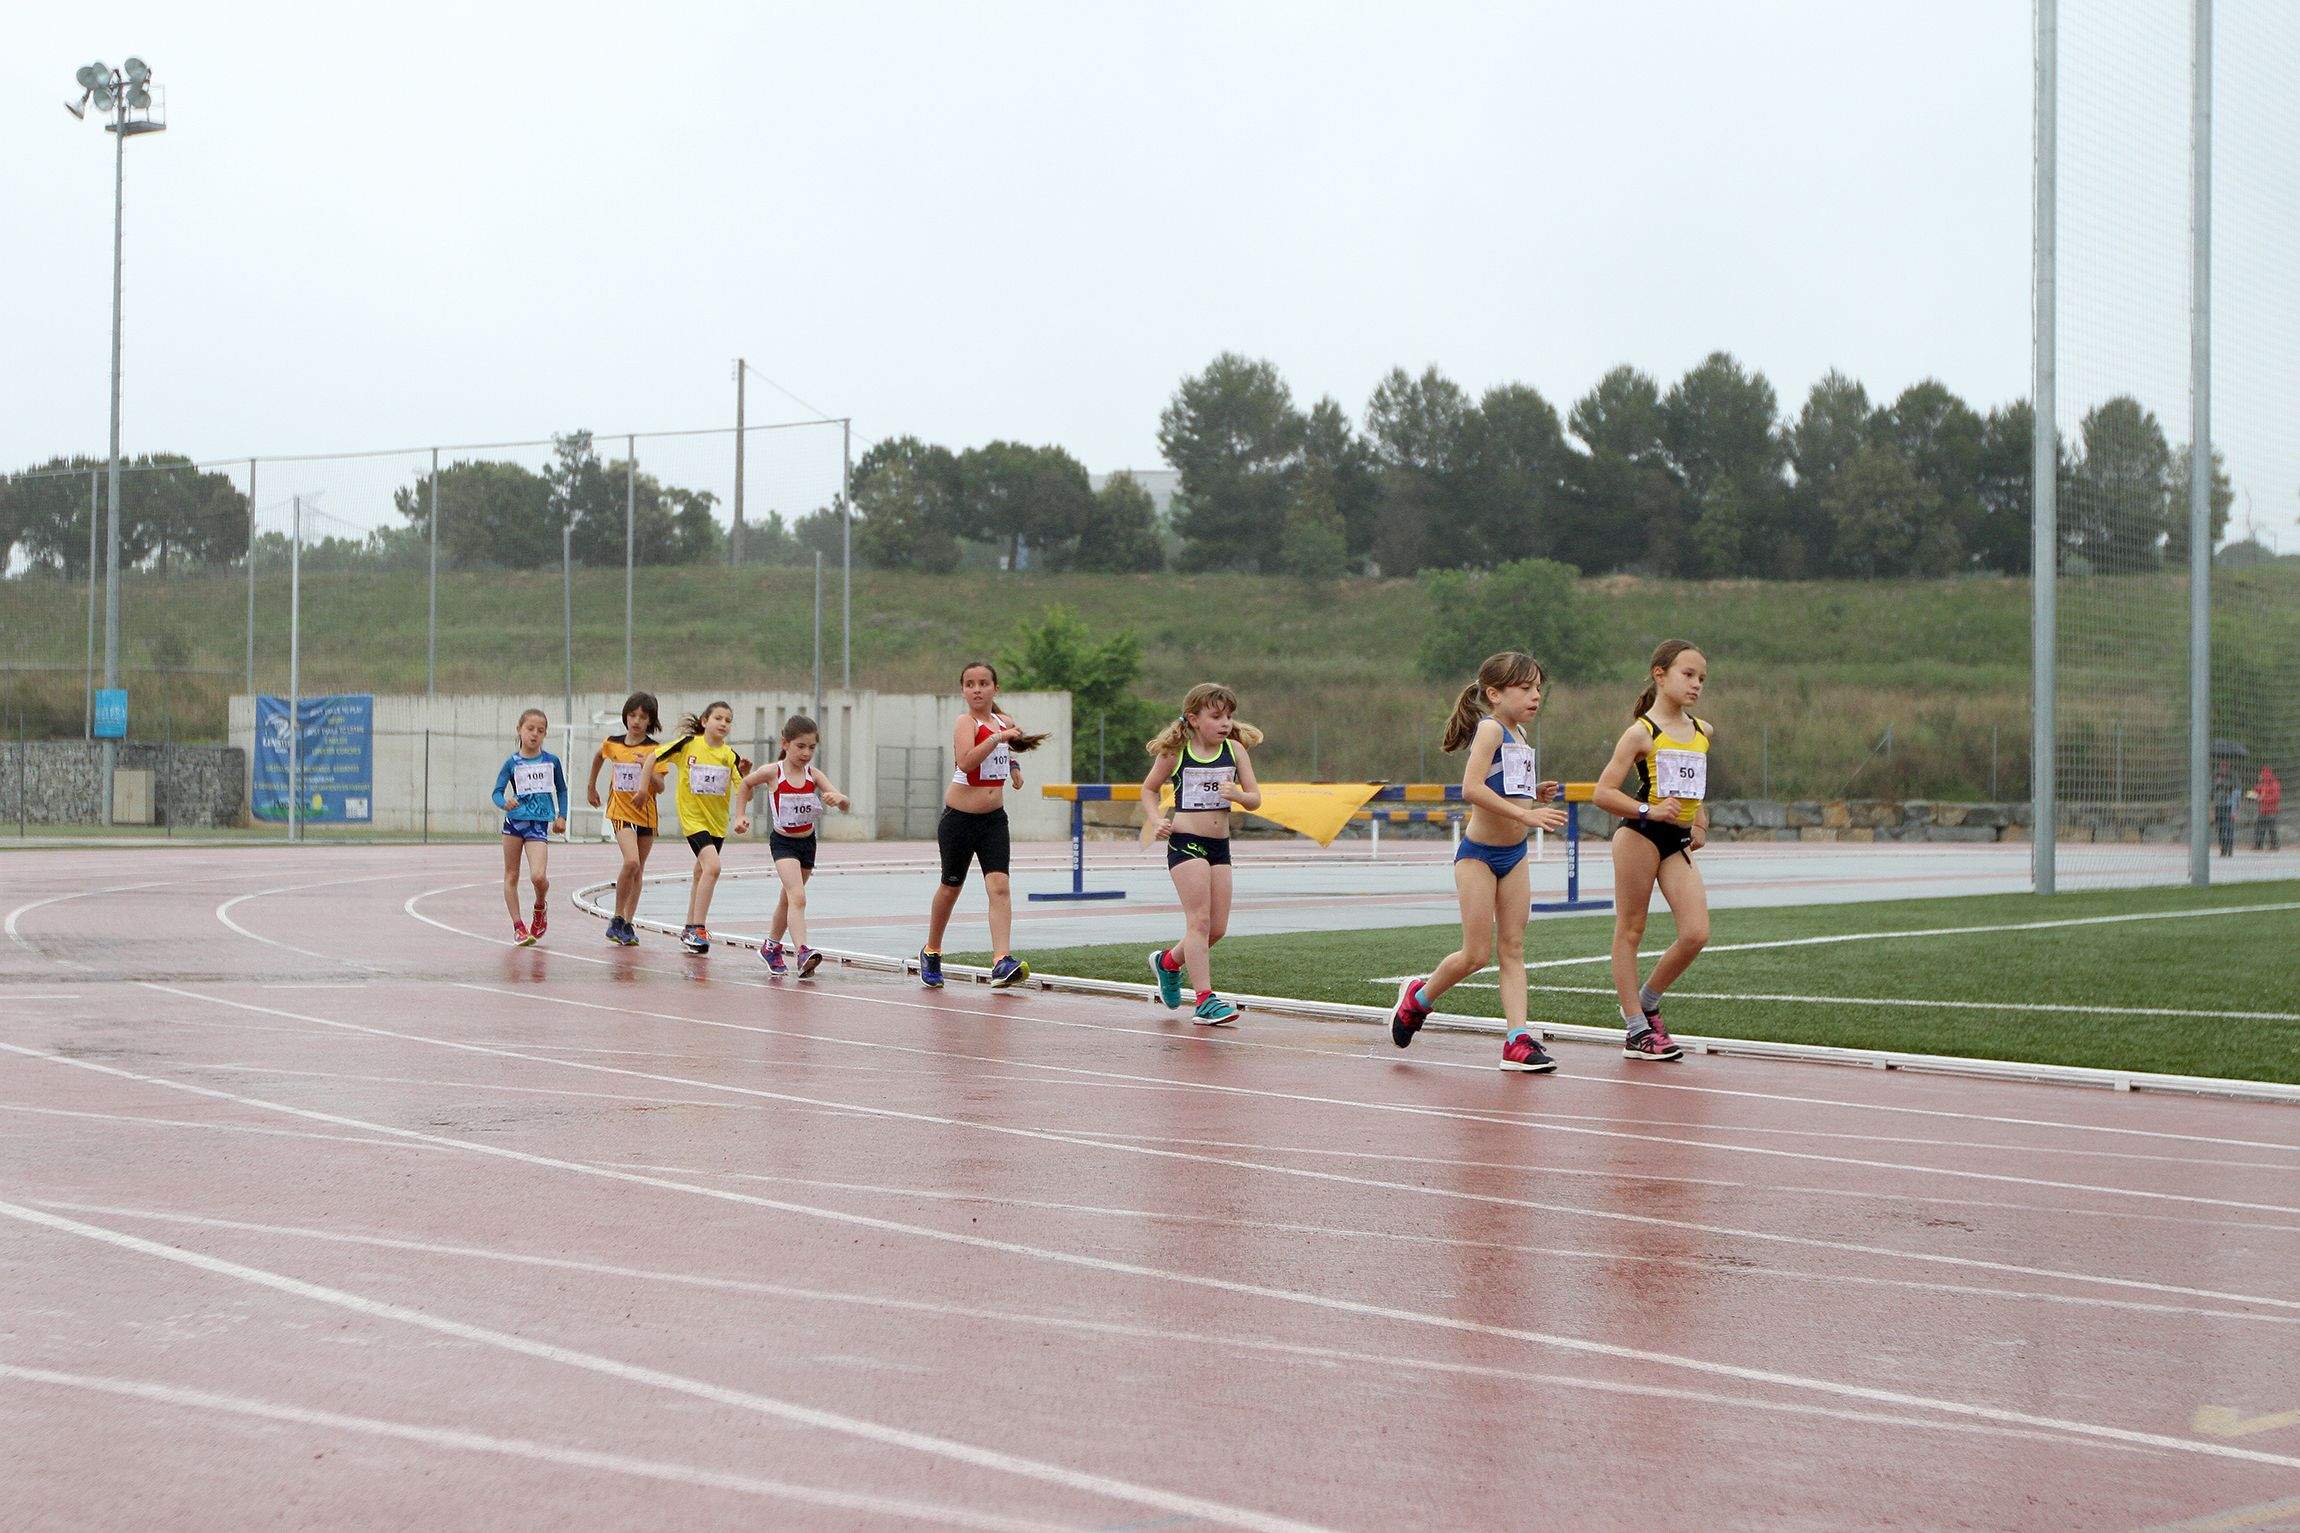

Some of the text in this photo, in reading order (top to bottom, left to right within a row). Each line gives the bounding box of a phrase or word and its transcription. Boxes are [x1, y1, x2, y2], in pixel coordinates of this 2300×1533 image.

[993, 755, 1008, 765] 107
[622, 773, 633, 781] 75
[1679, 767, 1695, 779] 50
[704, 775, 715, 783] 21
[1203, 781, 1219, 792] 58
[794, 805, 812, 814] 105
